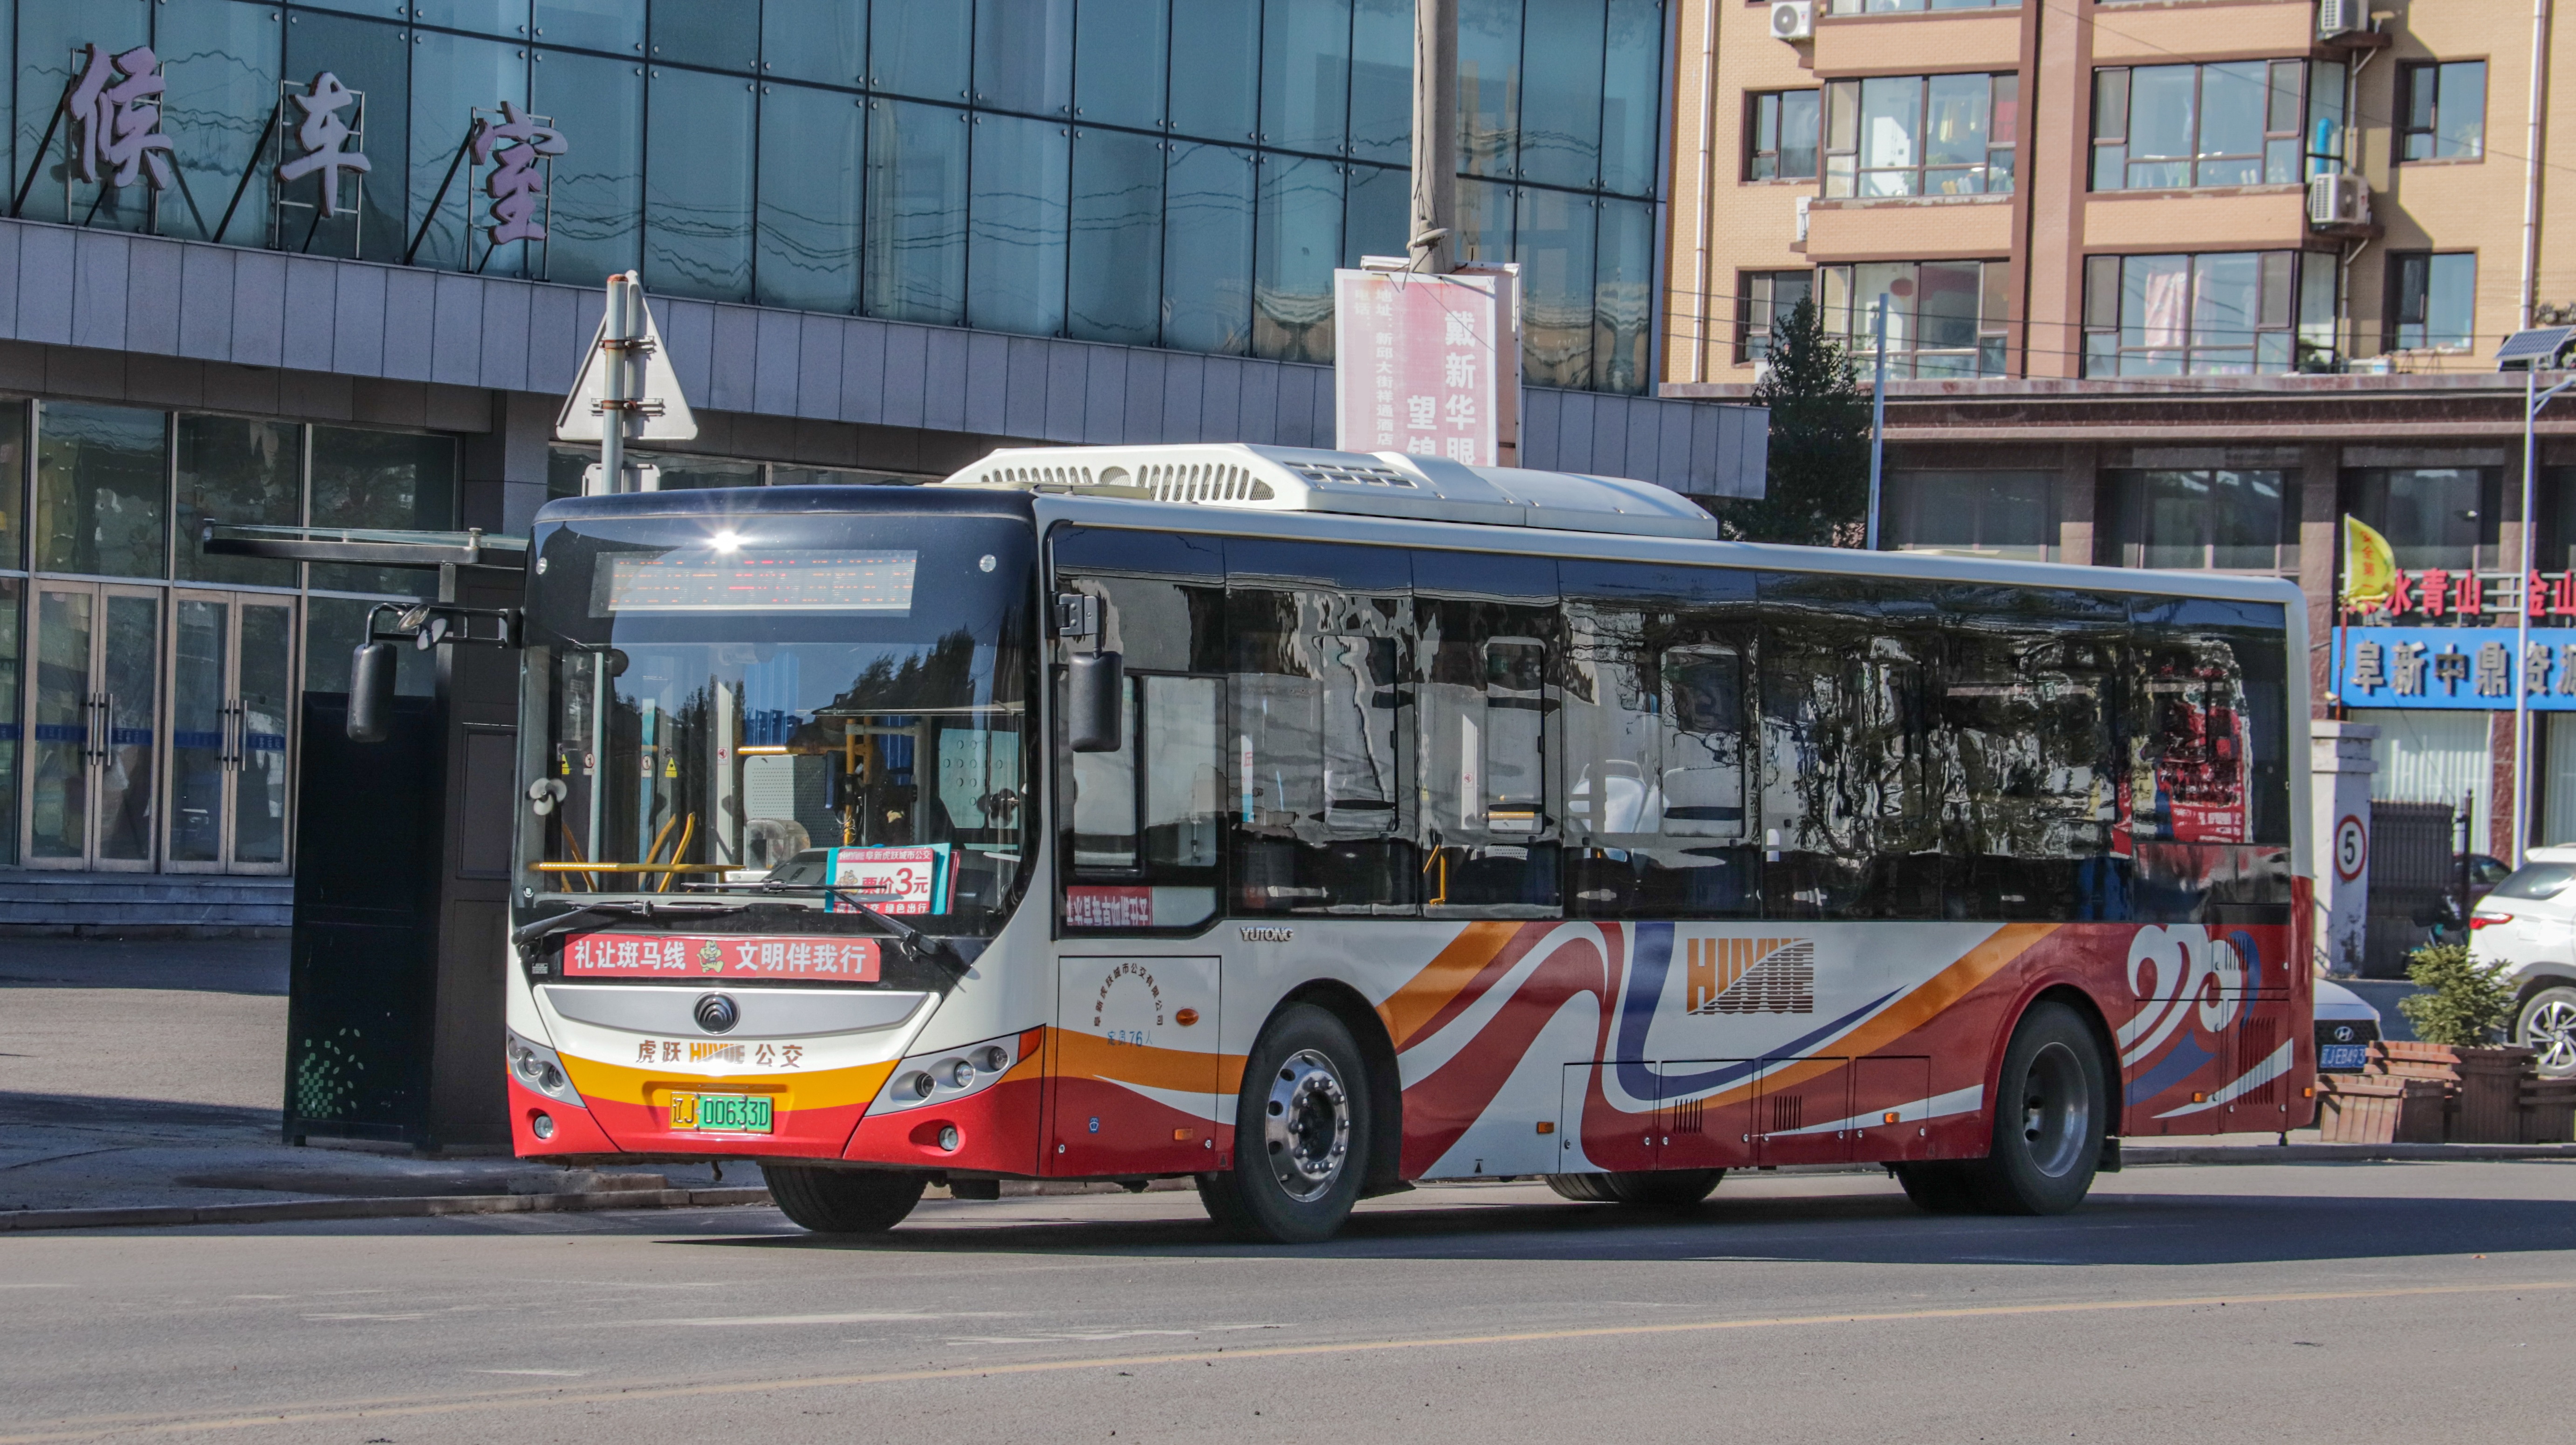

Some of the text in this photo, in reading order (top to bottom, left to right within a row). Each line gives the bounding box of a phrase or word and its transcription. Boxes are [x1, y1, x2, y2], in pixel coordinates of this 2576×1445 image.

[64, 43, 568, 245] 候车室
[2350, 568, 2482, 616] 水青山
[866, 850, 931, 860] 阜新虎跃城市公交
[2344, 830, 2356, 865] 5
[836, 903, 927, 913] 虎跃交 绿色出行
[1240, 927, 1294, 941] YUTONG
[575, 940, 867, 974] 礼让斑马线 文明伴我行
[1094, 963, 1164, 1027] 阜新虎跃城市公交有限公司
[636, 1040, 681, 1063] 虎跃
[755, 1044, 803, 1068] 公交
